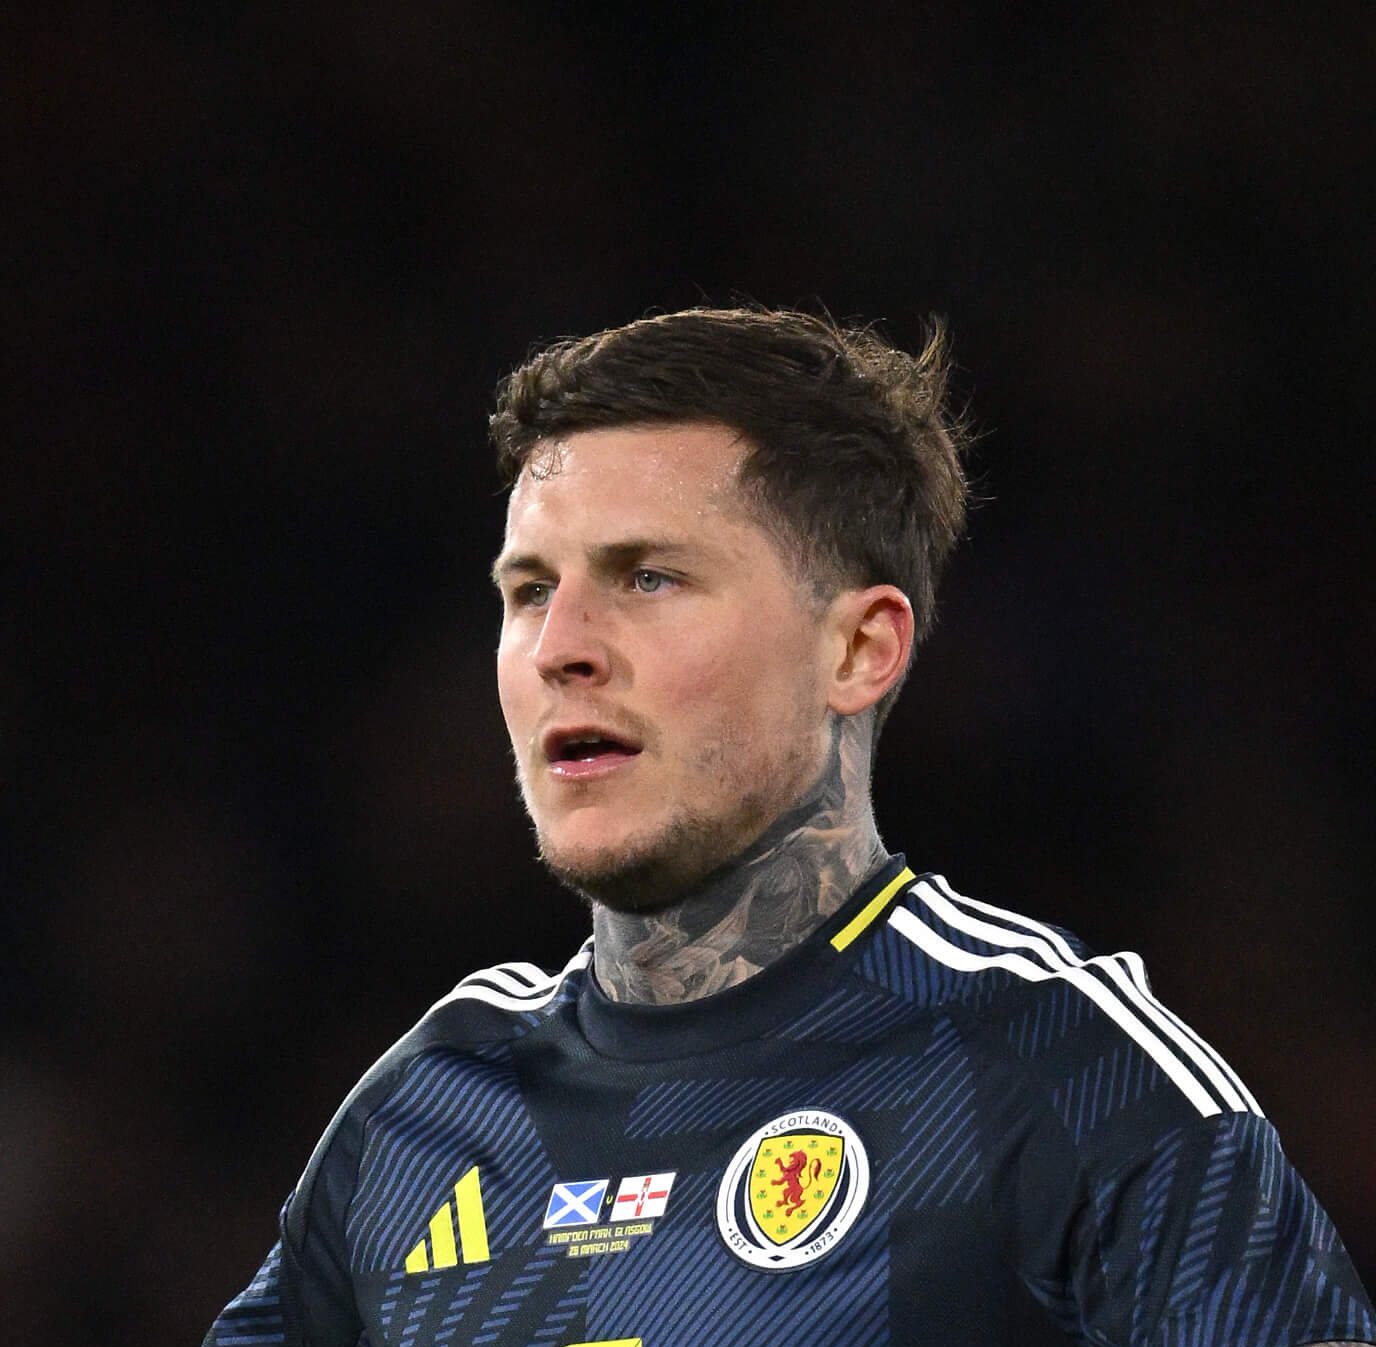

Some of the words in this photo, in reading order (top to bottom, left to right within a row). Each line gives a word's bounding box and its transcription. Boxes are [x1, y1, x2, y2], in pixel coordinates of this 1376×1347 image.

[771, 1115, 838, 1133] SCOTLAND
[609, 1240, 629, 1251] 2024
[729, 1231, 747, 1251] EST
[810, 1231, 835, 1253] 1873
